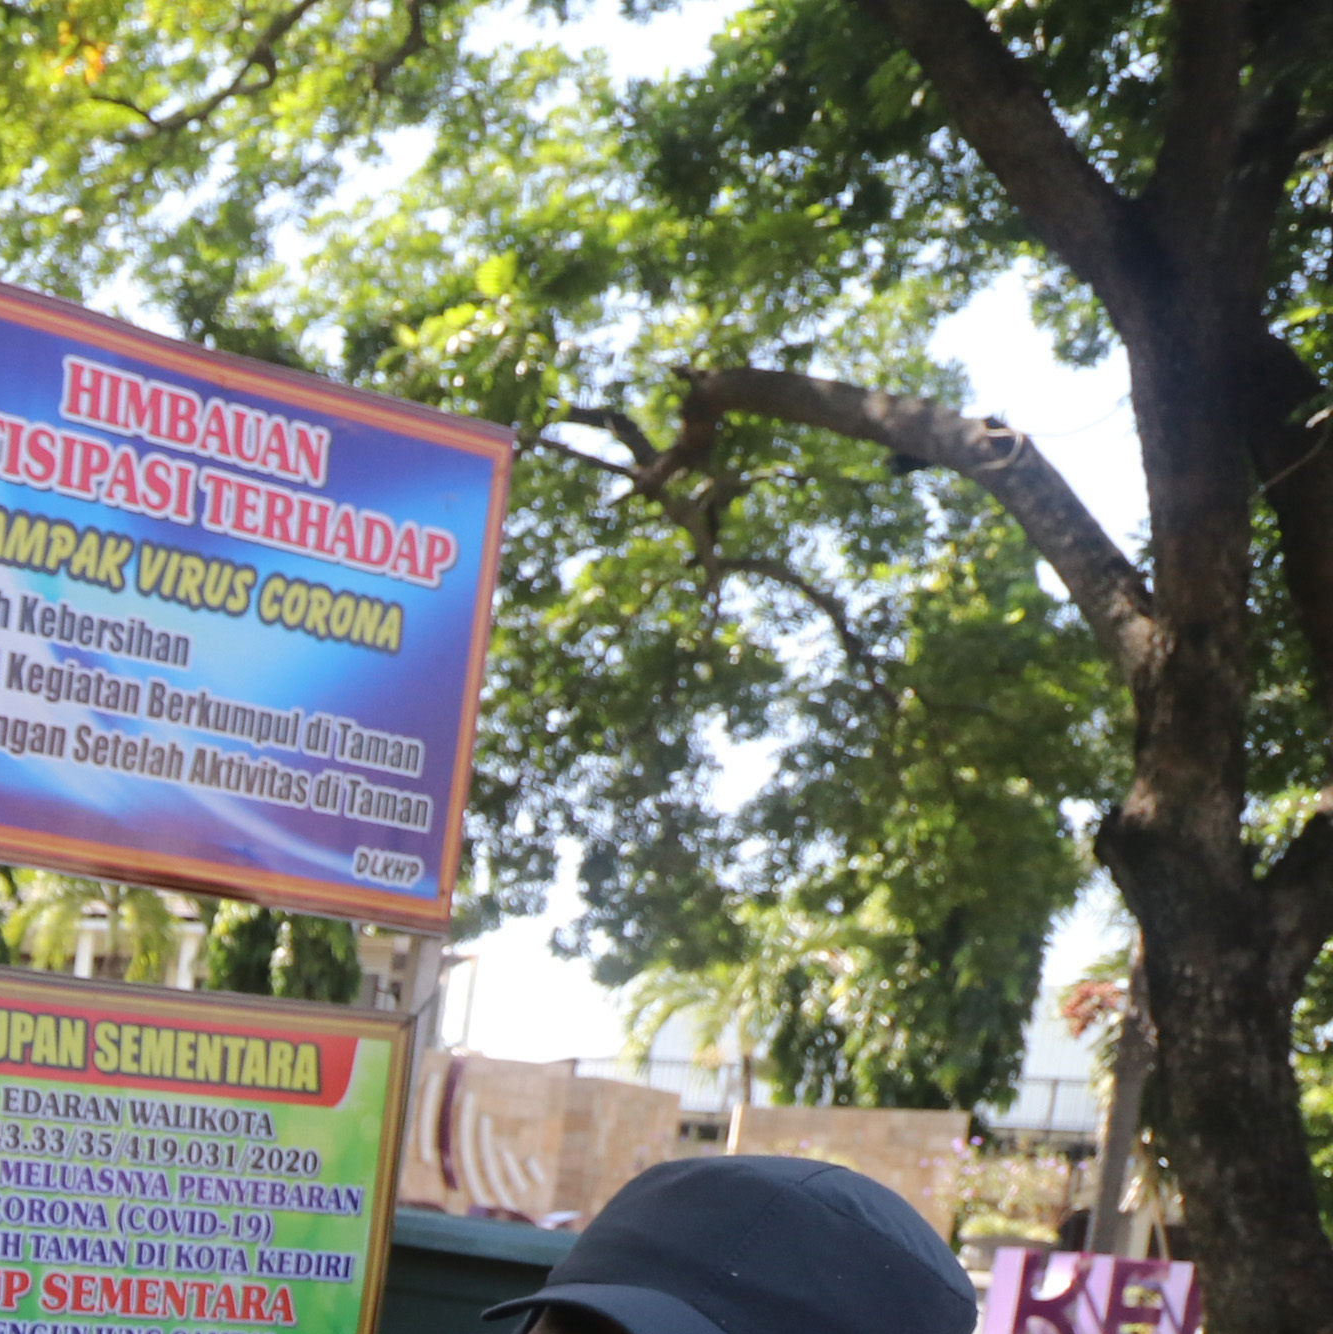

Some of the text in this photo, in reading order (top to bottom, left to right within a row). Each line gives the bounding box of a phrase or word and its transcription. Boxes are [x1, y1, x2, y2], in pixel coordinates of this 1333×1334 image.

[63, 360, 328, 482] HIMBAUAN
[201, 474, 454, 580] TERHADAP
[140, 549, 254, 611] VIRUS
[260, 577, 404, 648] CORONA
[19, 595, 190, 667] Kebersihan
[6, 653, 139, 714] Kegiatan
[148, 681, 300, 745] Berkumpul
[307, 711, 332, 753] di
[337, 720, 420, 773] Taman
[72, 726, 183, 779] Setelah
[189, 749, 307, 803] Aktivitas
[313, 771, 340, 811] di
[345, 780, 429, 829] Taman
[353, 851, 419, 883] DLKHP
[94, 1029, 320, 1092] SEMENTARA
[2, 1087, 122, 1123] EDARAN
[128, 1099, 274, 1138] WALIKOTA
[0, 1159, 171, 1198] MELUASNYA
[177, 1179, 363, 1214] PENYEBARAN
[116, 1206, 274, 1245] (COVID-19)
[28, 1236, 127, 1267] TAMAN
[136, 1241, 169, 1267] DI
[175, 1244, 250, 1274] KOTA
[256, 1251, 353, 1281] KEDIRI
[40, 1273, 296, 1323] SEMENTARA
